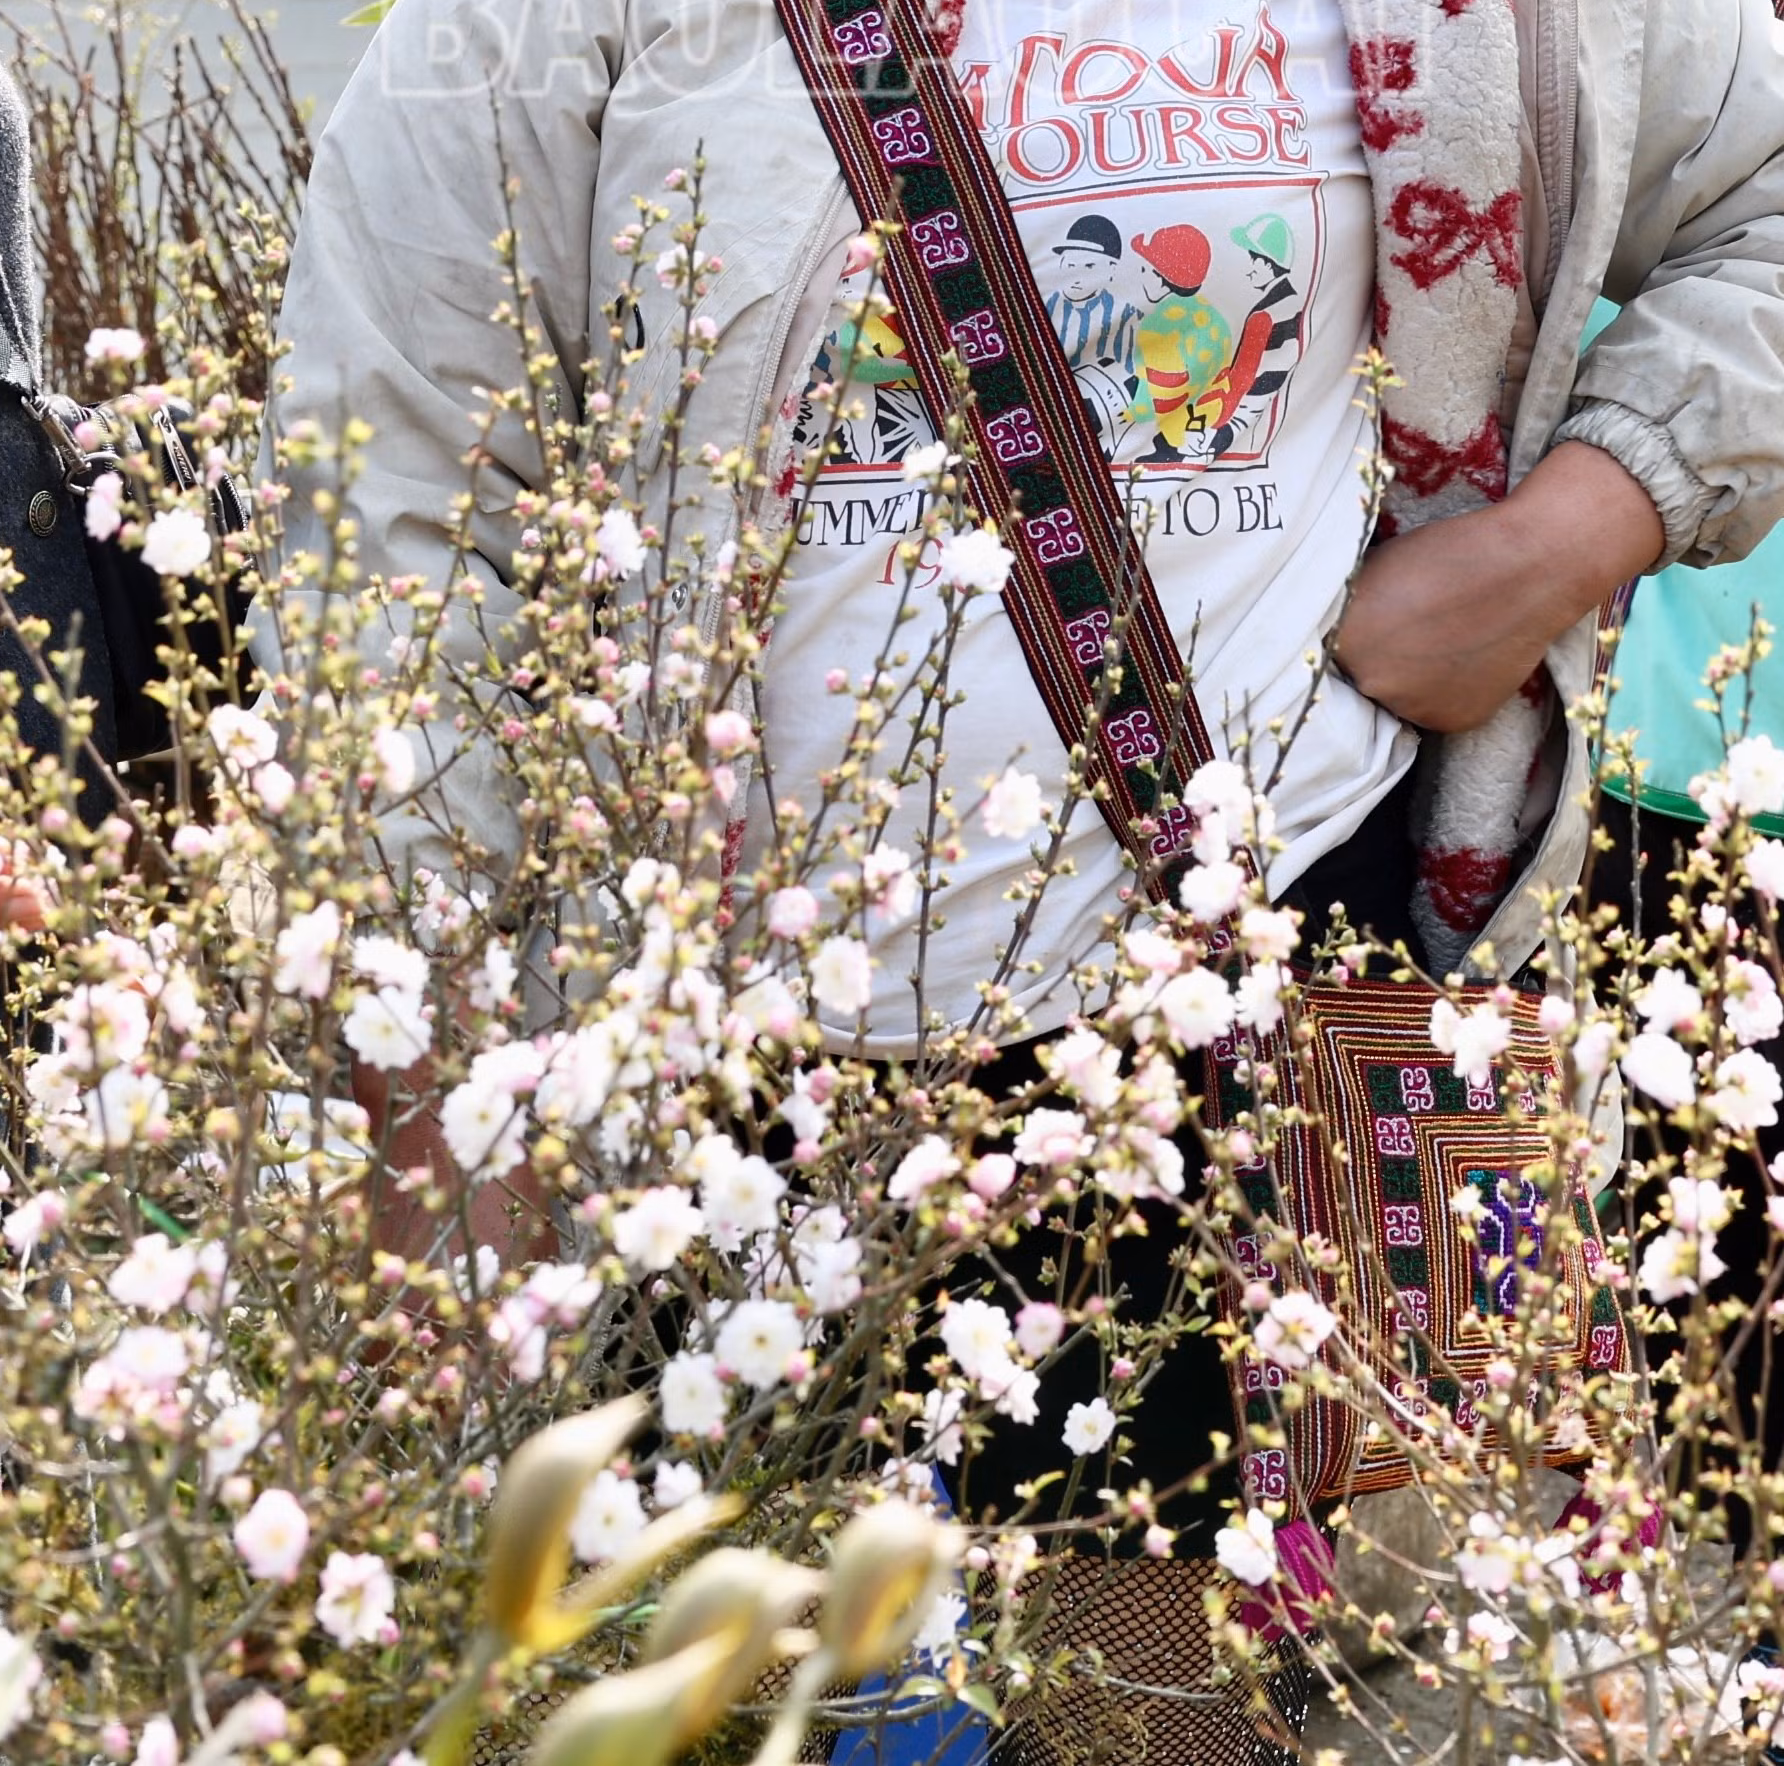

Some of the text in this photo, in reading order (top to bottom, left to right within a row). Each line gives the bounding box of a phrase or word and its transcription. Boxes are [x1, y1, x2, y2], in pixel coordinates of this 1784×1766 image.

[1004, 104, 1310, 184] OURSE
[1160, 487, 1221, 538] TO
[1233, 481, 1285, 534] BE
